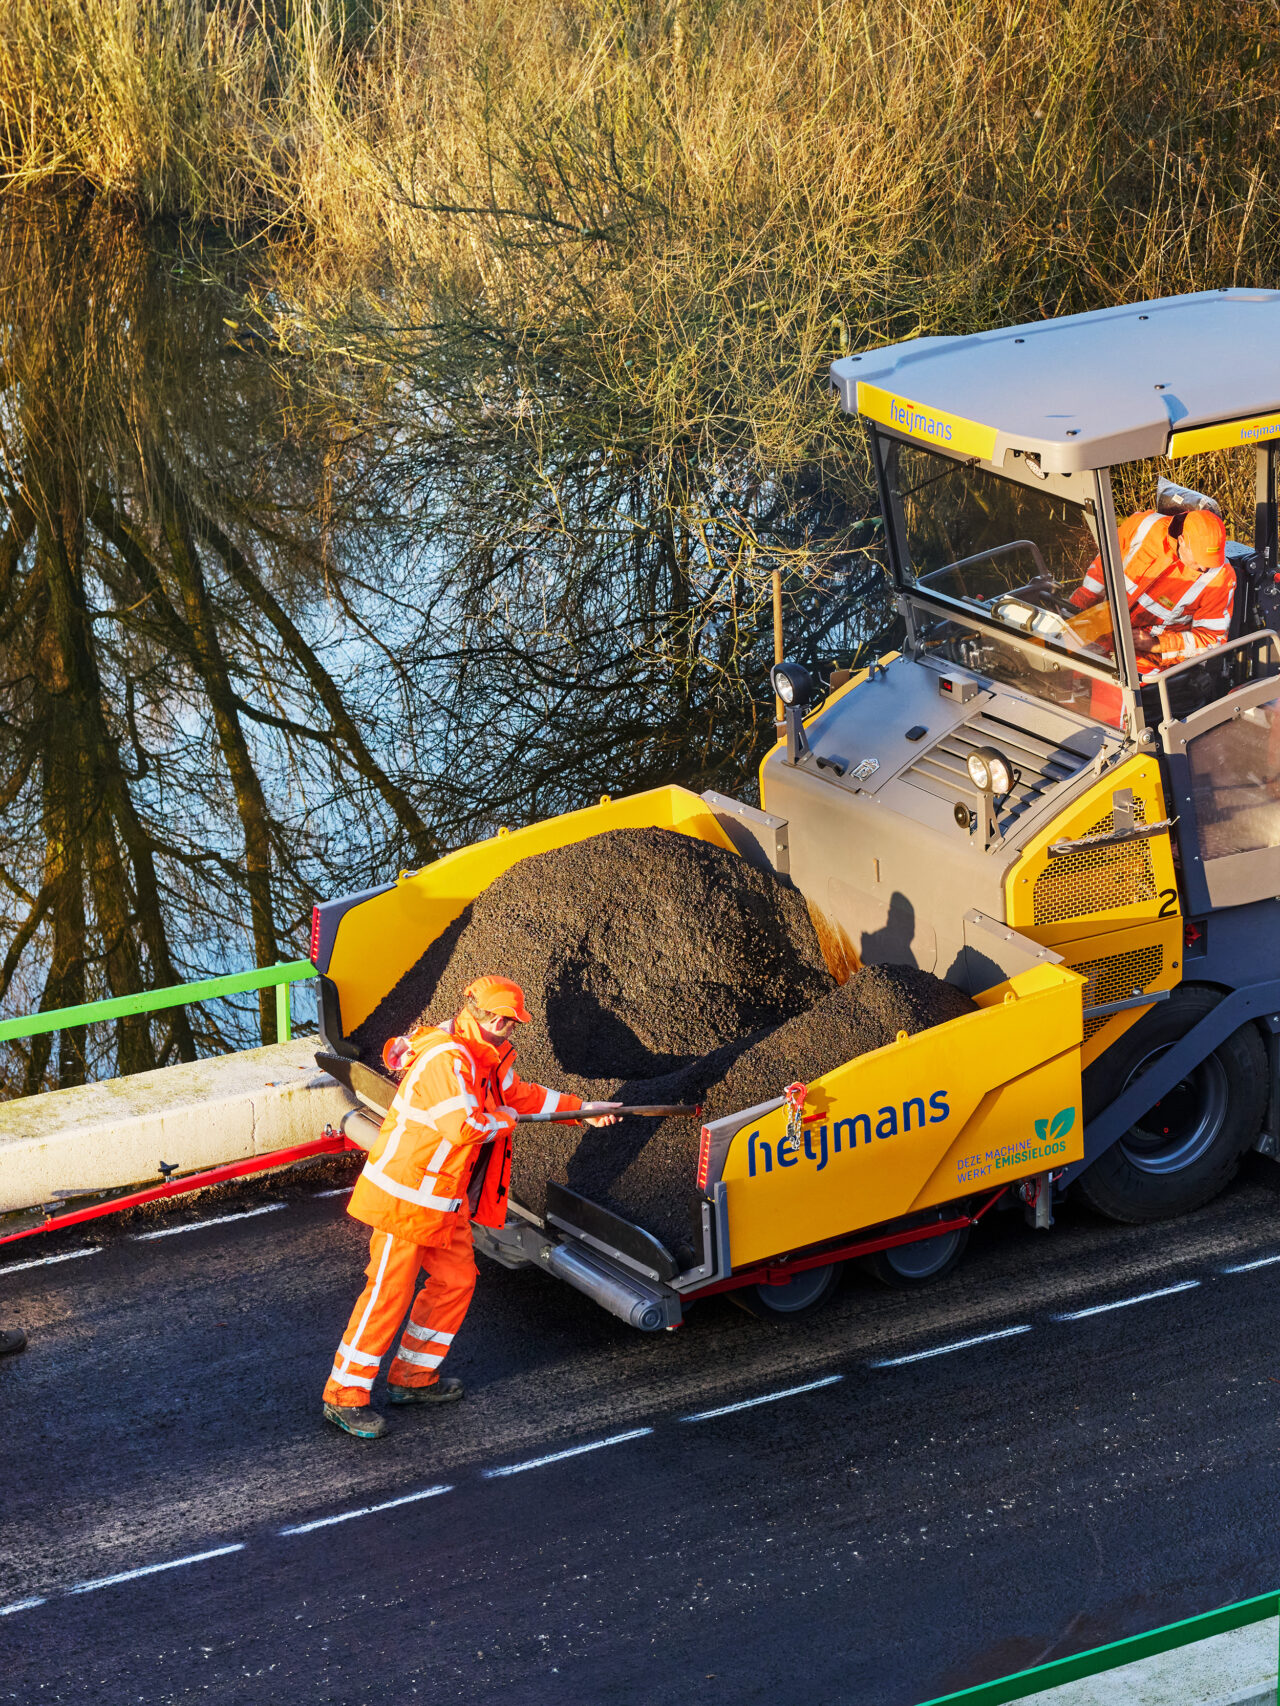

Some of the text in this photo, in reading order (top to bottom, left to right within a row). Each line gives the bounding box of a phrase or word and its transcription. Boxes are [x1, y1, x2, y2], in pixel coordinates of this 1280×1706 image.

[1158, 888, 1178, 918] 2
[957, 1138, 1032, 1170] DEZE MACHINE
[957, 1140, 1066, 1183] WERKT EMISSIELOOS
